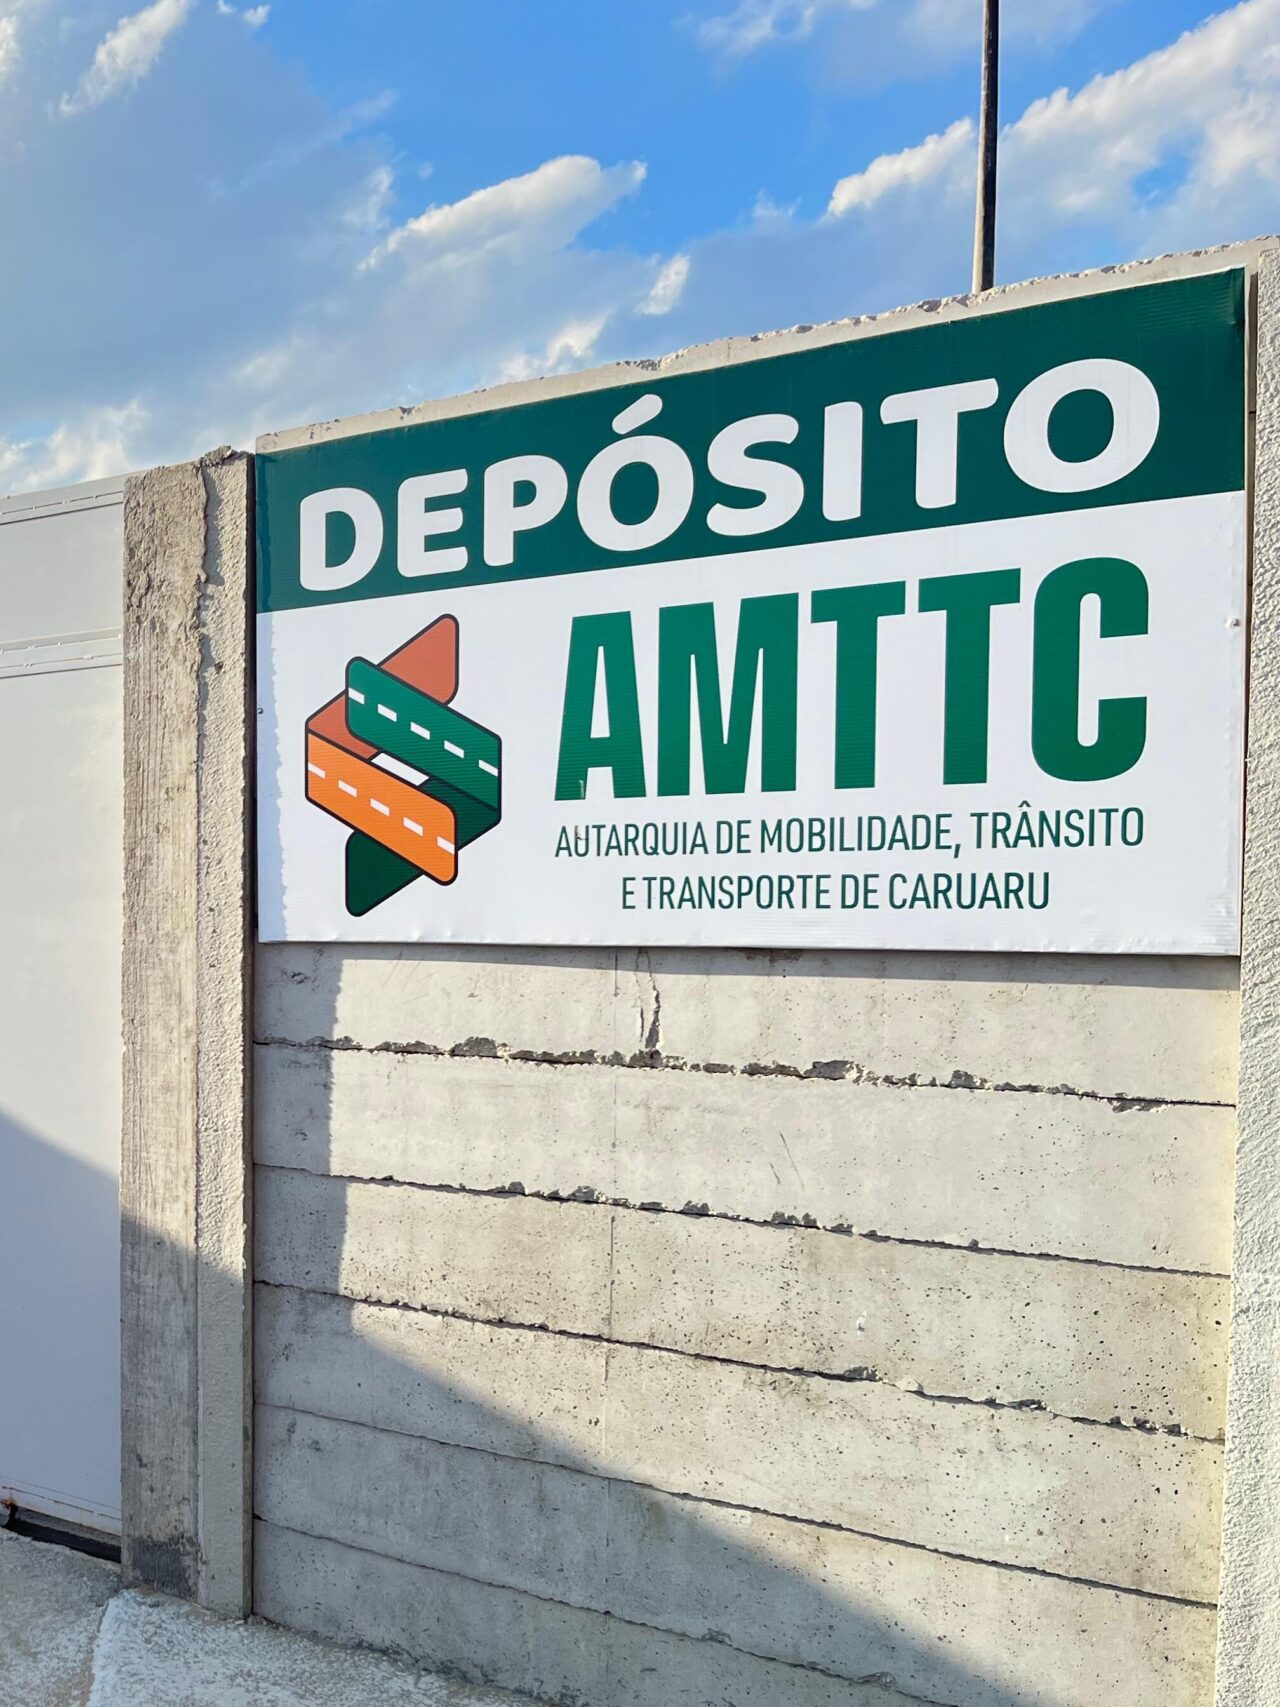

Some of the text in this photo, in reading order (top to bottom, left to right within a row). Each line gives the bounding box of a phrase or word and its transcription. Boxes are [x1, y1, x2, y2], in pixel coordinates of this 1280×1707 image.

[298, 357, 1161, 592] DEPÓSITO
[554, 556, 1150, 802] AMTTC
[554, 800, 1144, 859] AUTARQUIA DE MOBILIDADE, TRÂNSITO
[622, 871, 1050, 910] E TRANSPORTE DE CARUARU
